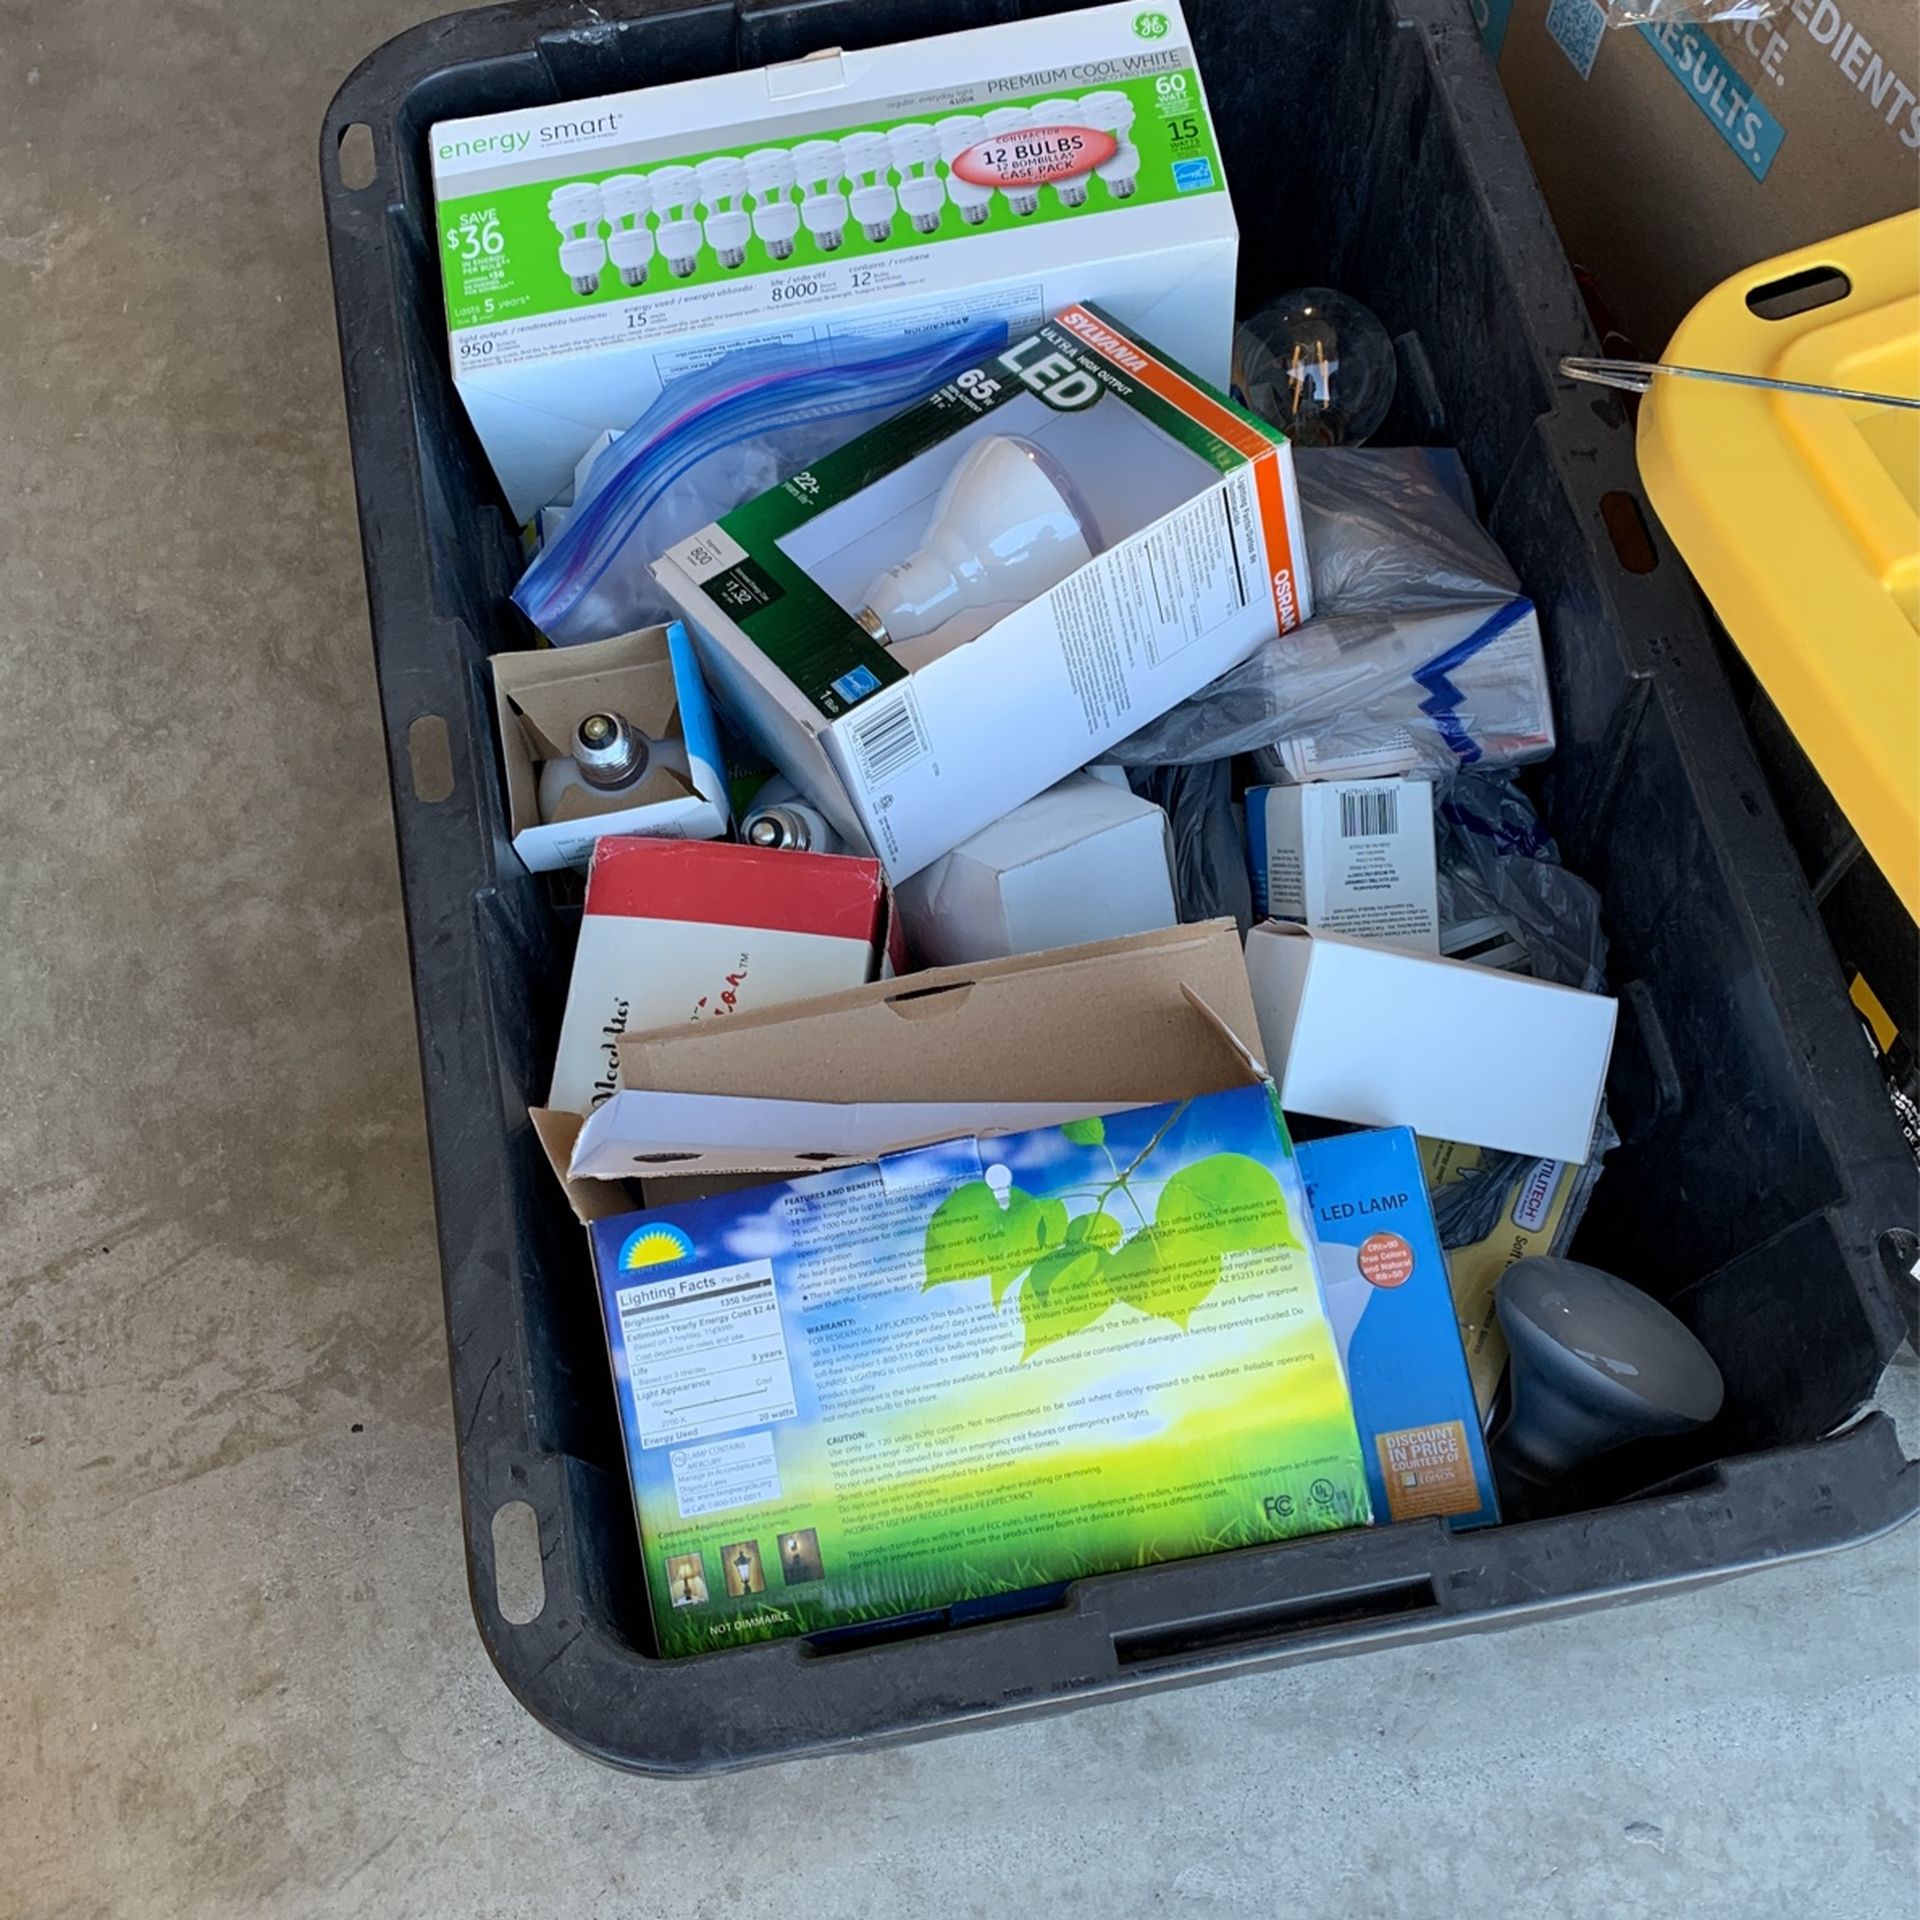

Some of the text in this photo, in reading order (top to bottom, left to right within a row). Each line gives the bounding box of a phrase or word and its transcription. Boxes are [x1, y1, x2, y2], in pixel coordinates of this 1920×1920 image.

[1732, 20, 1789, 86] CE.
[988, 49, 1180, 94] PREMIUM COOL WHITE
[1155, 74, 1186, 94] 60
[1654, 22, 1763, 163] ESULTS.
[1167, 119, 1198, 142] 15
[438, 130, 531, 160] energy
[983, 135, 1083, 165] 12 BULBS
[997, 152, 1075, 172] 12 BOMBILLAS
[1001, 161, 1074, 180] CASE PACK
[459, 208, 497, 226] SAVE
[446, 220, 504, 259] $36
[851, 272, 872, 288] 12
[484, 298, 494, 312] 5
[626, 312, 648, 329] 15
[460, 340, 493, 360] 950
[1063, 312, 1149, 373] SYLVANIA
[998, 338, 1099, 408] LED
[1040, 327, 1134, 396] ULTRA HIGH OUTPUT
[793, 472, 820, 495] 22+
[1274, 569, 1296, 633] OSRAM
[784, 1190, 825, 1206] FEATURES
[825, 1186, 845, 1197] AND
[1320, 1191, 1409, 1221] LED LAMP
[833, 1234, 880, 1250] temperature
[930, 1213, 979, 1230] performance
[1360, 1248, 1407, 1264] True Colors
[1508, 1234, 1528, 1260] Soft
[1363, 1258, 1411, 1274] and Natural
[620, 1285, 677, 1307] Lighting
[679, 1276, 716, 1293] Facts
[741, 1290, 773, 1302] lumens
[624, 1312, 670, 1329] Brightness
[627, 1326, 669, 1342] Estimated
[671, 1319, 697, 1334] Yearly
[700, 1314, 730, 1329] Energy
[732, 1307, 752, 1319] Cost
[808, 1335, 824, 1346] FOR
[824, 1325, 873, 1342] RESIDENTIAL
[947, 1305, 965, 1317] bulb
[894, 1338, 920, 1351] phone
[920, 1331, 951, 1344] number
[759, 1349, 783, 1361] years
[895, 1356, 938, 1373] committed
[949, 1348, 979, 1362] making
[979, 1343, 999, 1356] high
[633, 1368, 648, 1377] Life
[637, 1378, 711, 1402] Light Appearance
[1065, 1396, 1087, 1408] used
[1087, 1391, 1112, 1403] where
[1114, 1384, 1144, 1399] directly
[1145, 1377, 1179, 1393] exposed
[759, 1408, 794, 1421] 20 watts
[836, 1407, 860, 1420] return
[874, 1400, 893, 1411] bulb
[643, 1429, 698, 1447] Energy Used
[825, 1430, 868, 1446] CAUTION:
[1384, 1425, 1454, 1448] DISCOUNT
[1388, 1437, 1458, 1462] IN PRICE
[1391, 1451, 1461, 1472] COURTESY OF
[1419, 1470, 1455, 1484] EDISON
[709, 1611, 792, 1636] NOT DIMMABLE
